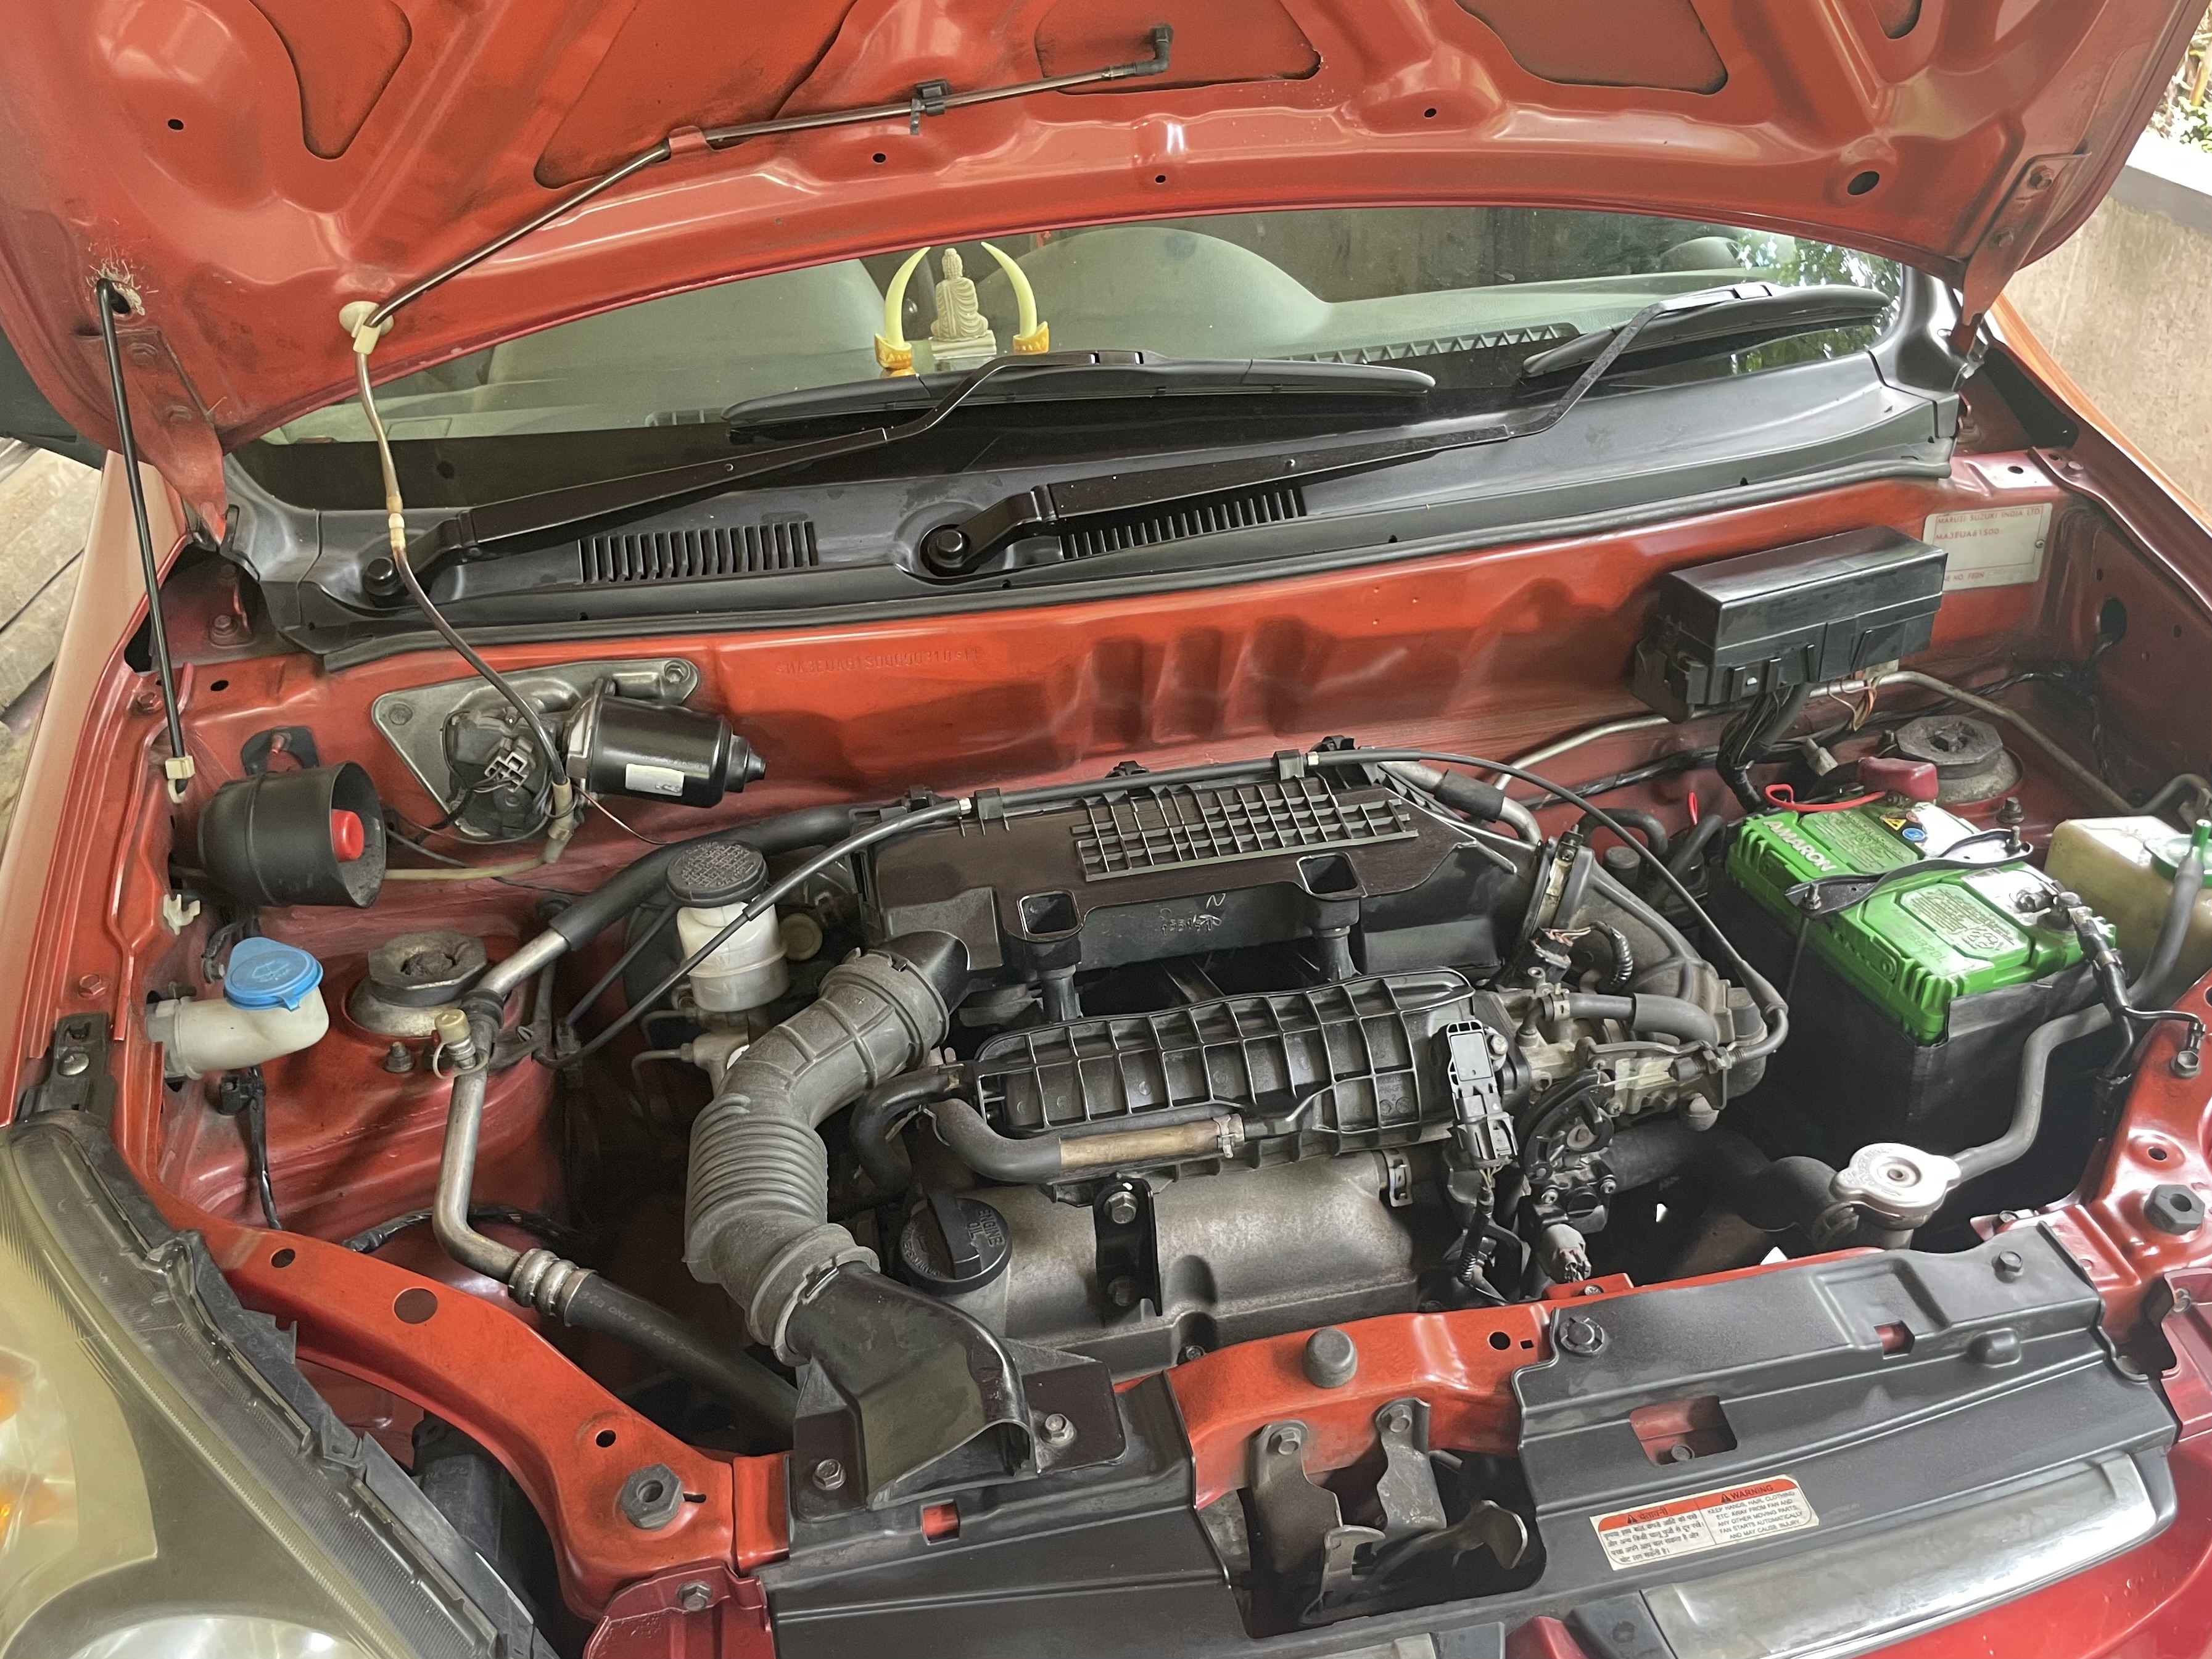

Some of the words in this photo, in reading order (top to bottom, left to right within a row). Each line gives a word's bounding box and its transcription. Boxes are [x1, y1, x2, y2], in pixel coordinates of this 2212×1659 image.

[1938, 515, 1966, 524] MARUTI
[1970, 513, 1997, 521] SUZUKI
[2001, 509, 2023, 518] INDIA
[1763, 821, 1837, 872] AMARON
[968, 1222, 984, 1240] OIL
[978, 1209, 1005, 1247] ENGINE
[608, 1306, 636, 1322] ONLY
[1730, 1484, 1773, 1499] WARNING
[1765, 1491, 1795, 1502] CLOTHING
[1731, 1509, 1747, 1517] AWAY
[1749, 1504, 1767, 1512] FROM
[1731, 1515, 1752, 1524] OTHER
[1754, 1510, 1777, 1519] MOVING
[1733, 1521, 1756, 1531] STARTS
[1757, 1511, 1802, 1525] AUTOMATICALLY
[1757, 1524, 1778, 1533] CAUSE
